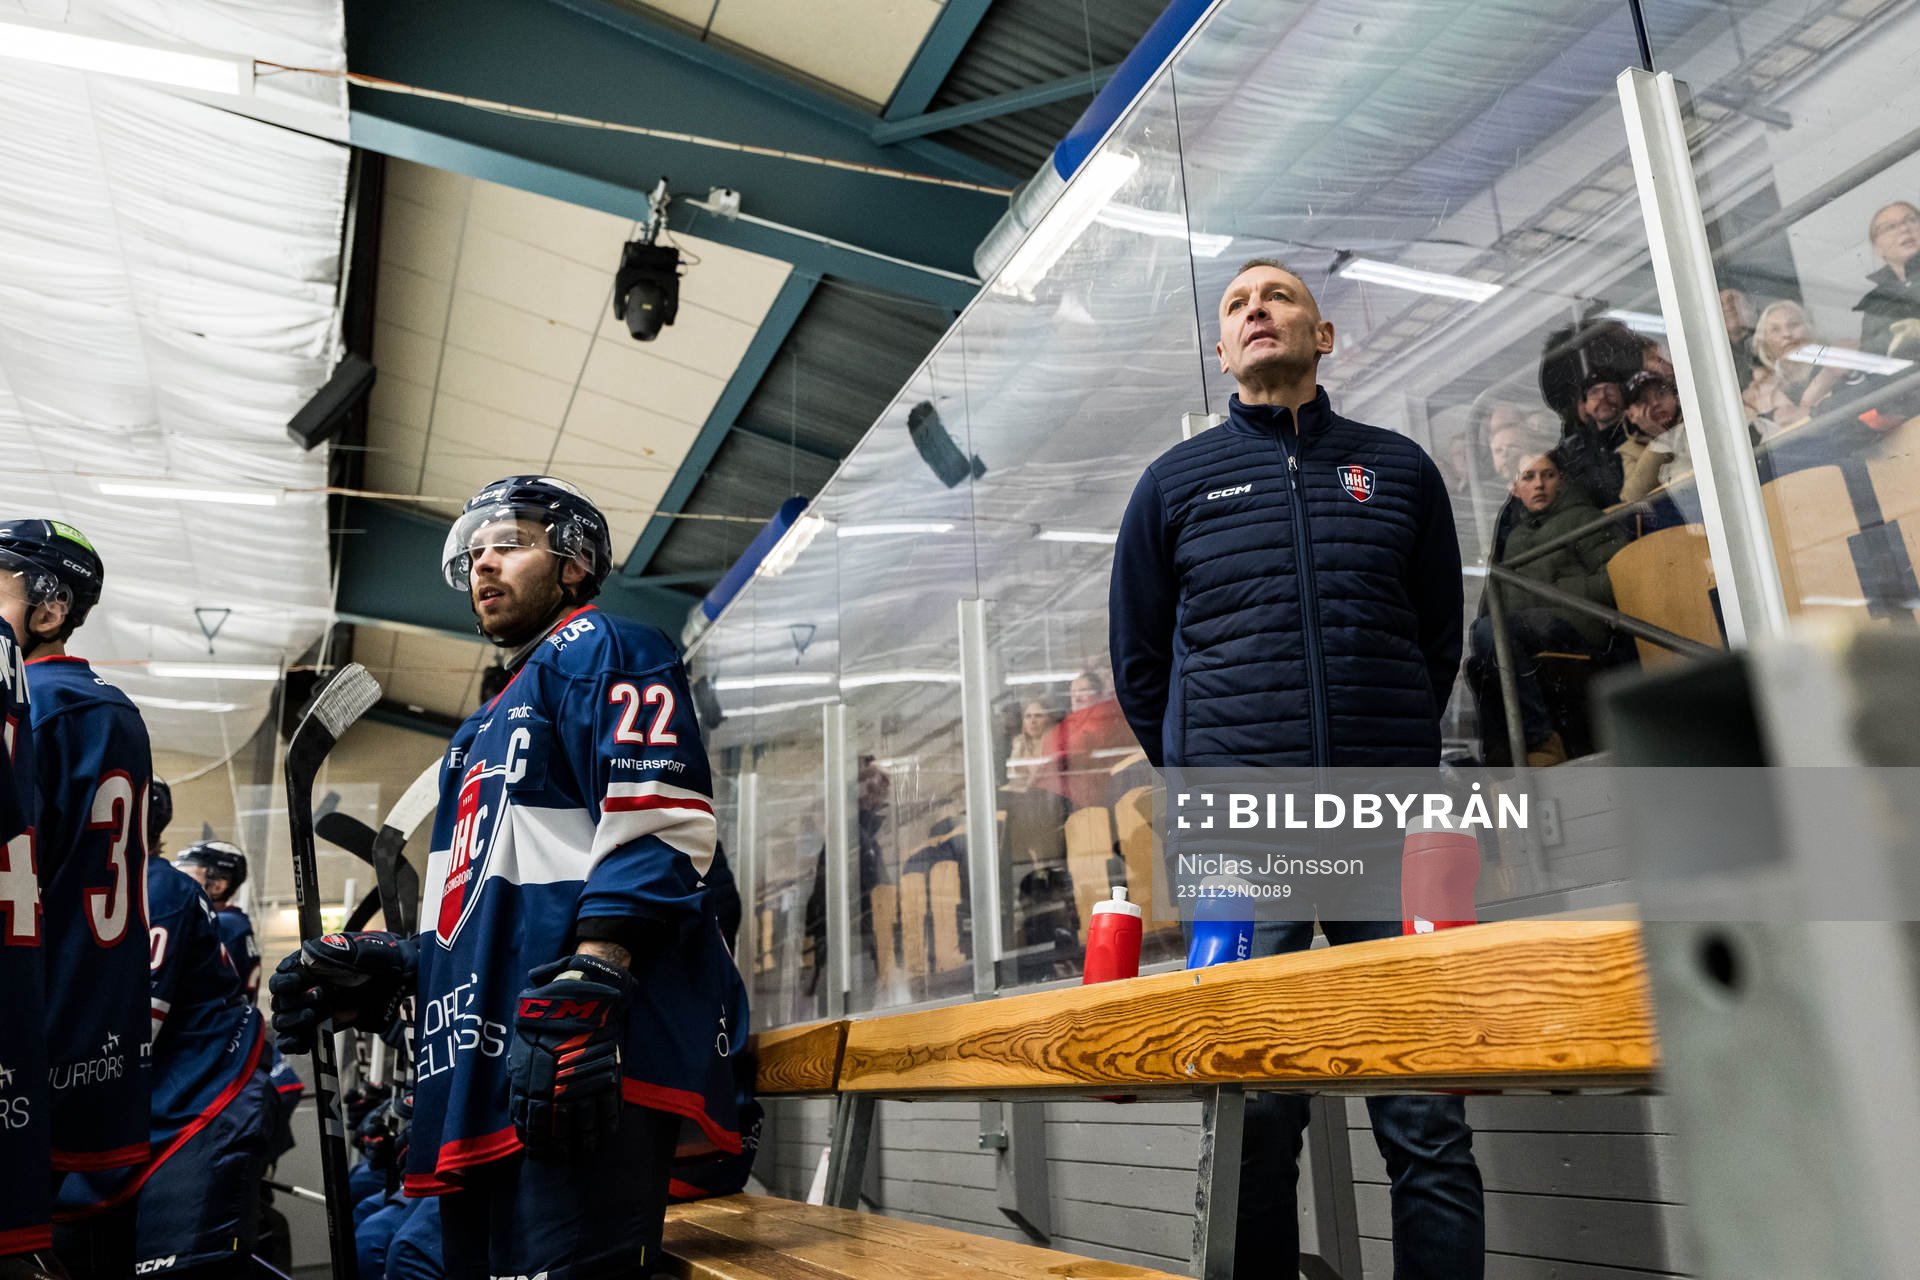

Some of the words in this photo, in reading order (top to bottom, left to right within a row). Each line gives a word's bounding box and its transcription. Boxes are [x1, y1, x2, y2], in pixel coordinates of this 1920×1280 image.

[1343, 472, 1371, 489] HHC
[1206, 484, 1252, 500] CCM
[573, 514, 599, 531] CCM
[62, 559, 92, 577] CCM
[609, 683, 679, 746] 22
[505, 727, 531, 784] C
[617, 758, 687, 774] INTERSPORT
[294, 859, 304, 903] CCM
